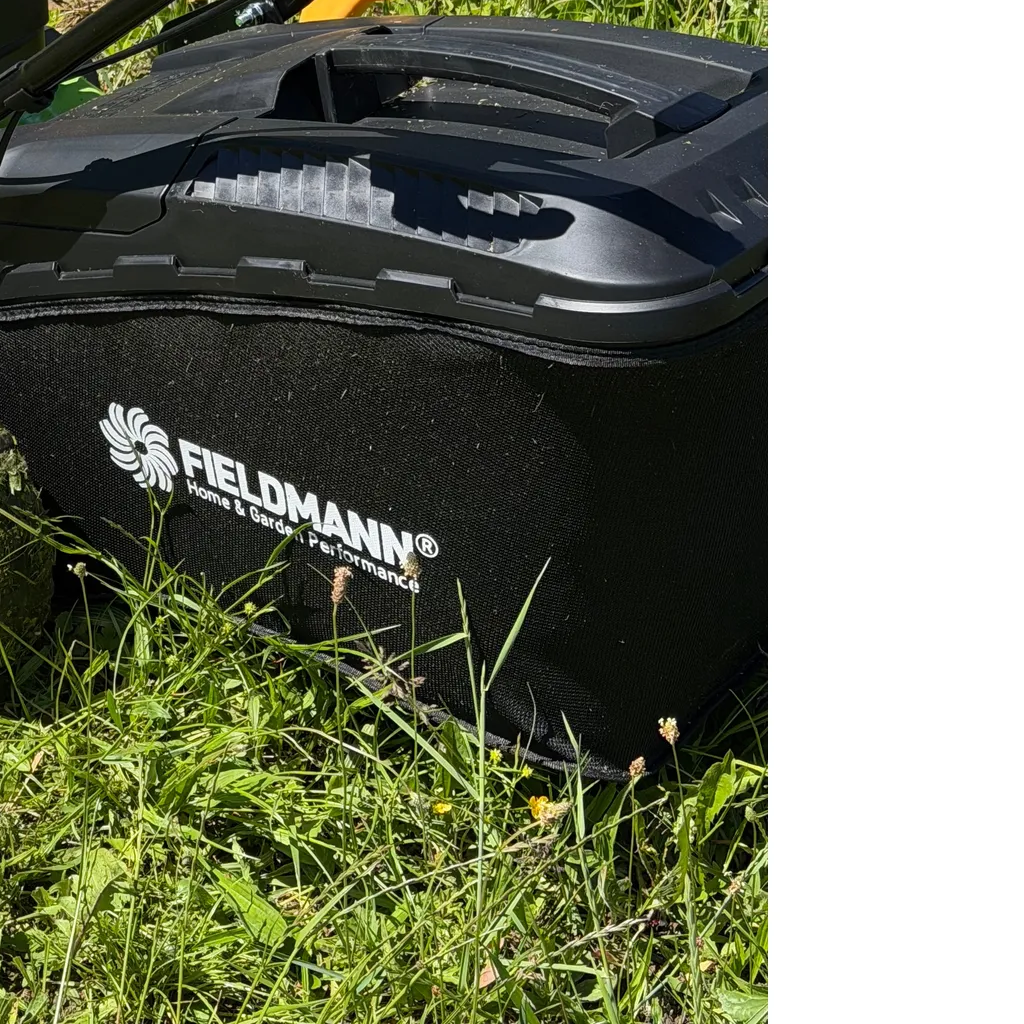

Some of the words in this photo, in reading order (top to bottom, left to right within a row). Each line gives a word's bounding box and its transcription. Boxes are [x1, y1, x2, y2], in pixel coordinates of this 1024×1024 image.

[187, 478, 231, 510] Home
[234, 499, 246, 517] &
[249, 505, 304, 544] Garden
[308, 531, 420, 593] Performance
